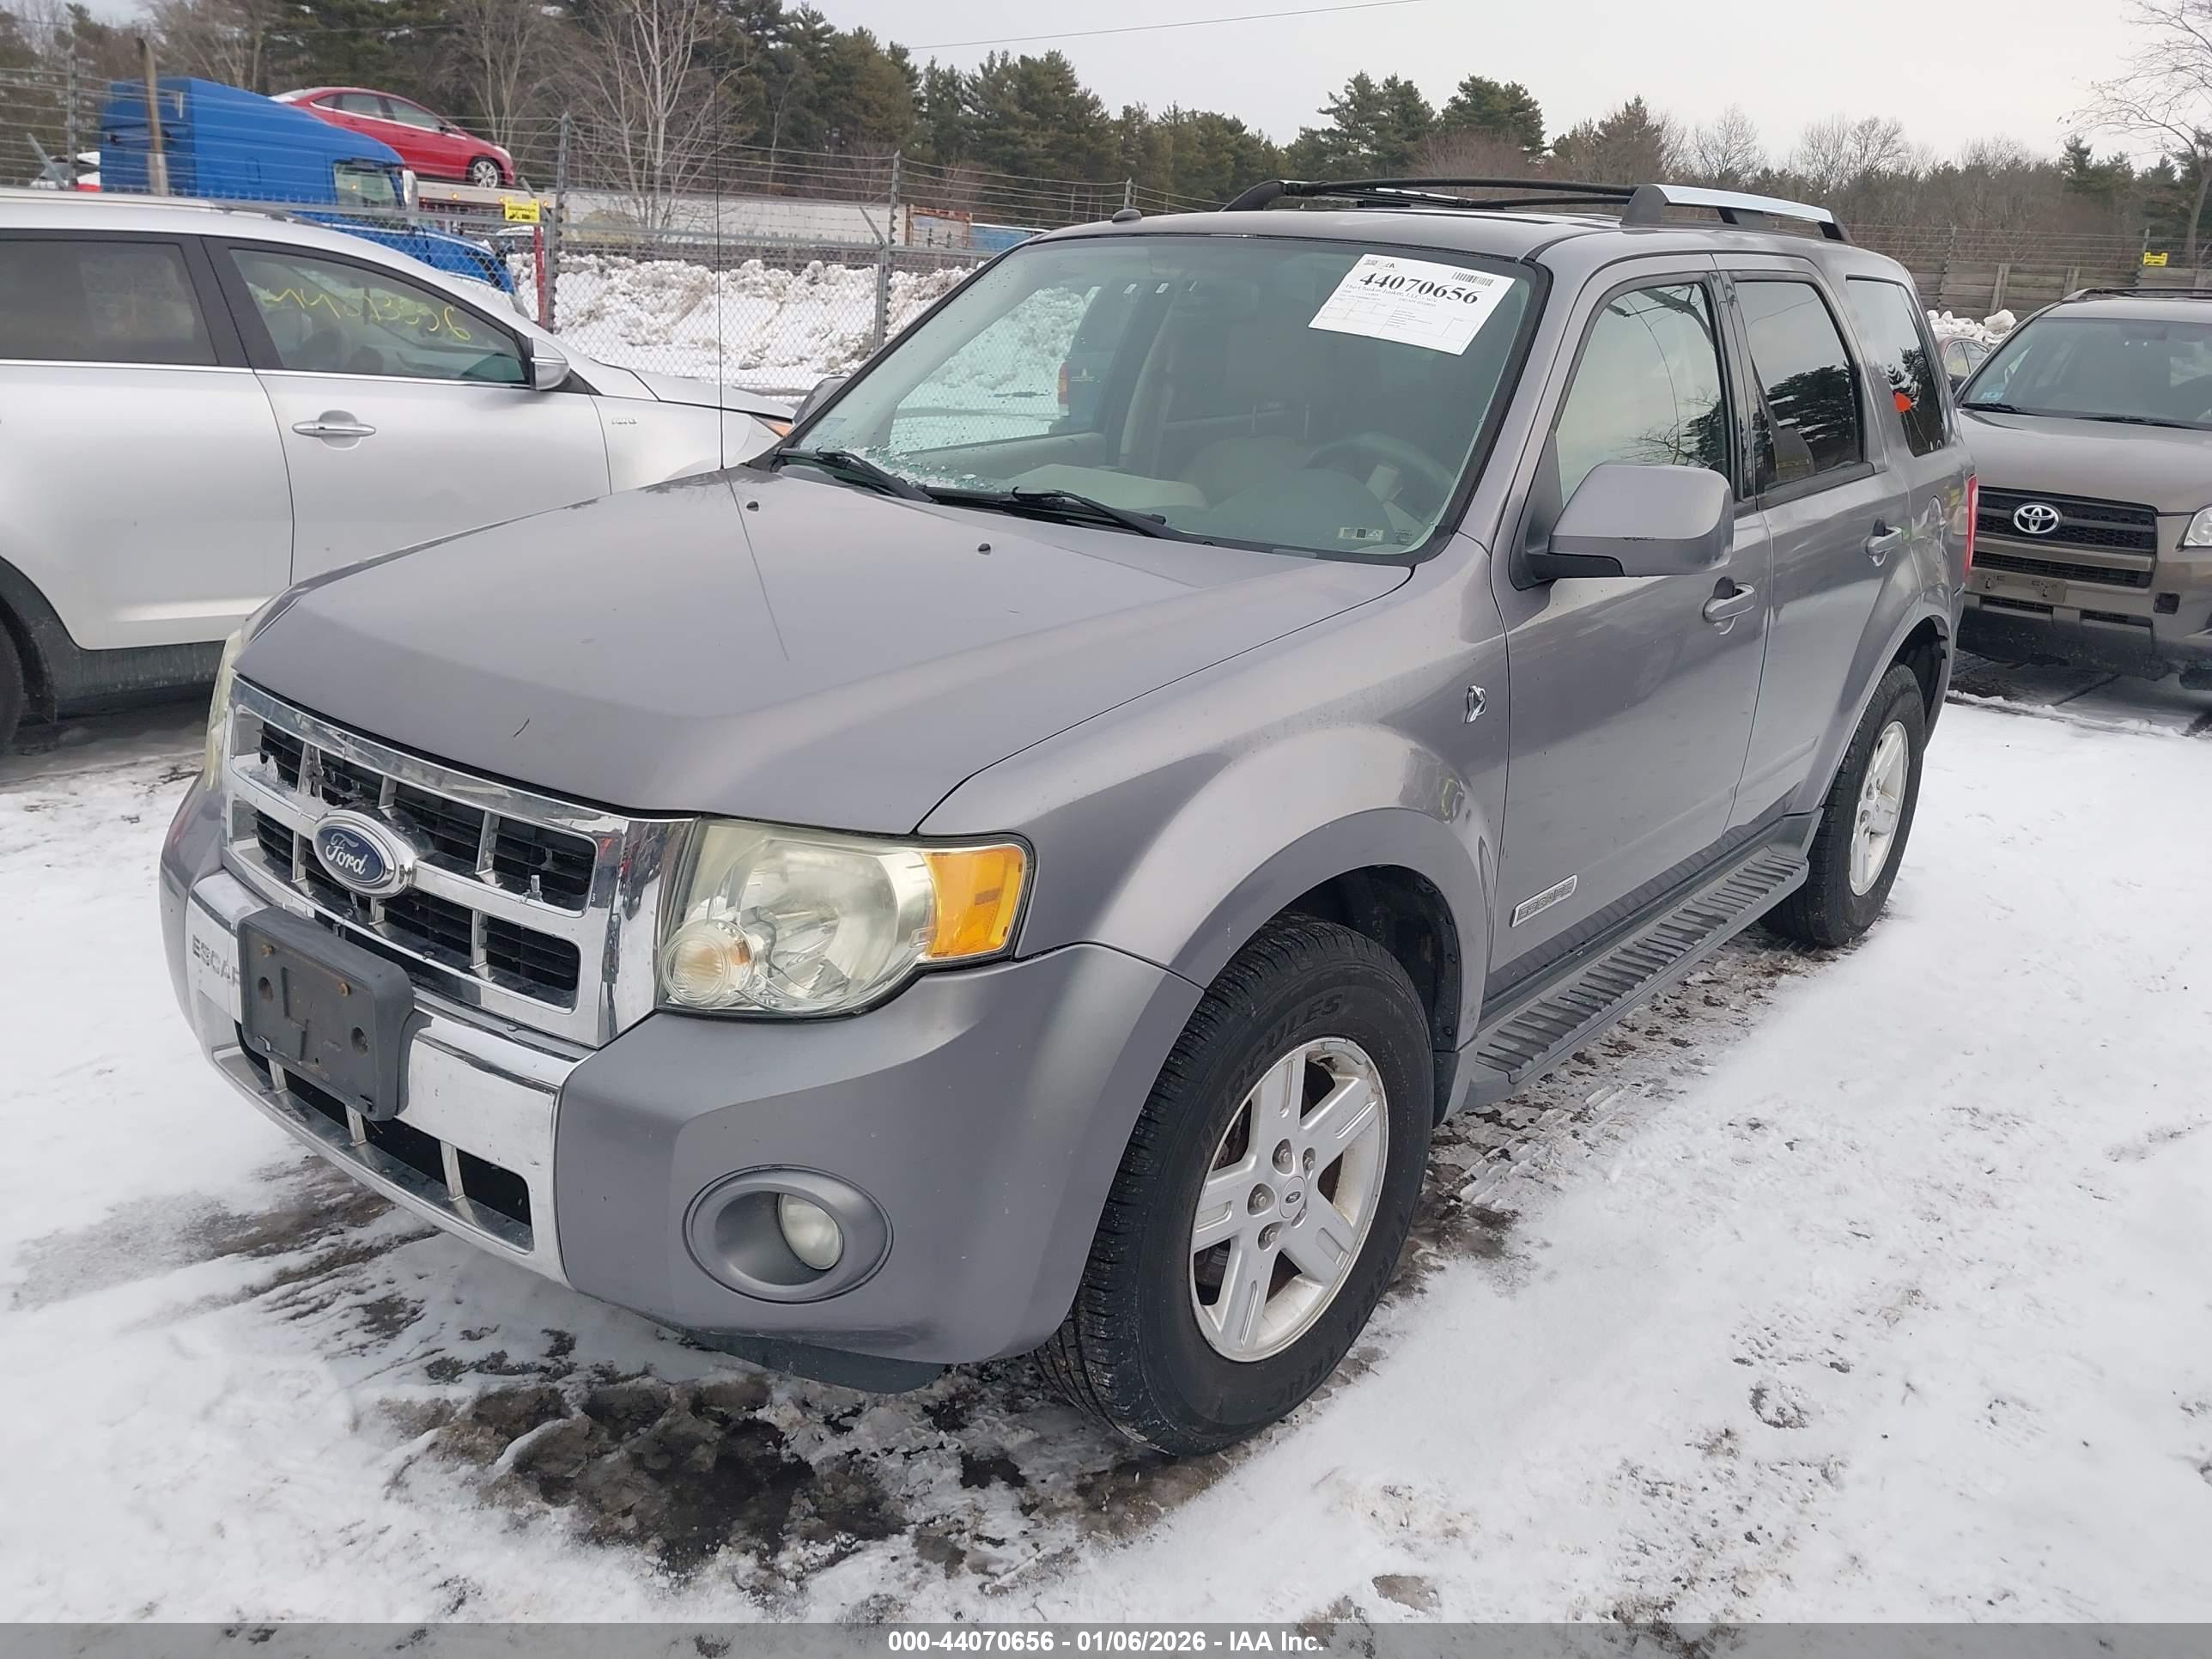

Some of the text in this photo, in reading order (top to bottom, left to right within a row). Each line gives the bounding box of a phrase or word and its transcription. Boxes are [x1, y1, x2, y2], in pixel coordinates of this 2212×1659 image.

[1359, 272, 1484, 305] 44070656
[325, 833, 368, 875] Ford
[192, 934, 240, 987] ESCAP
